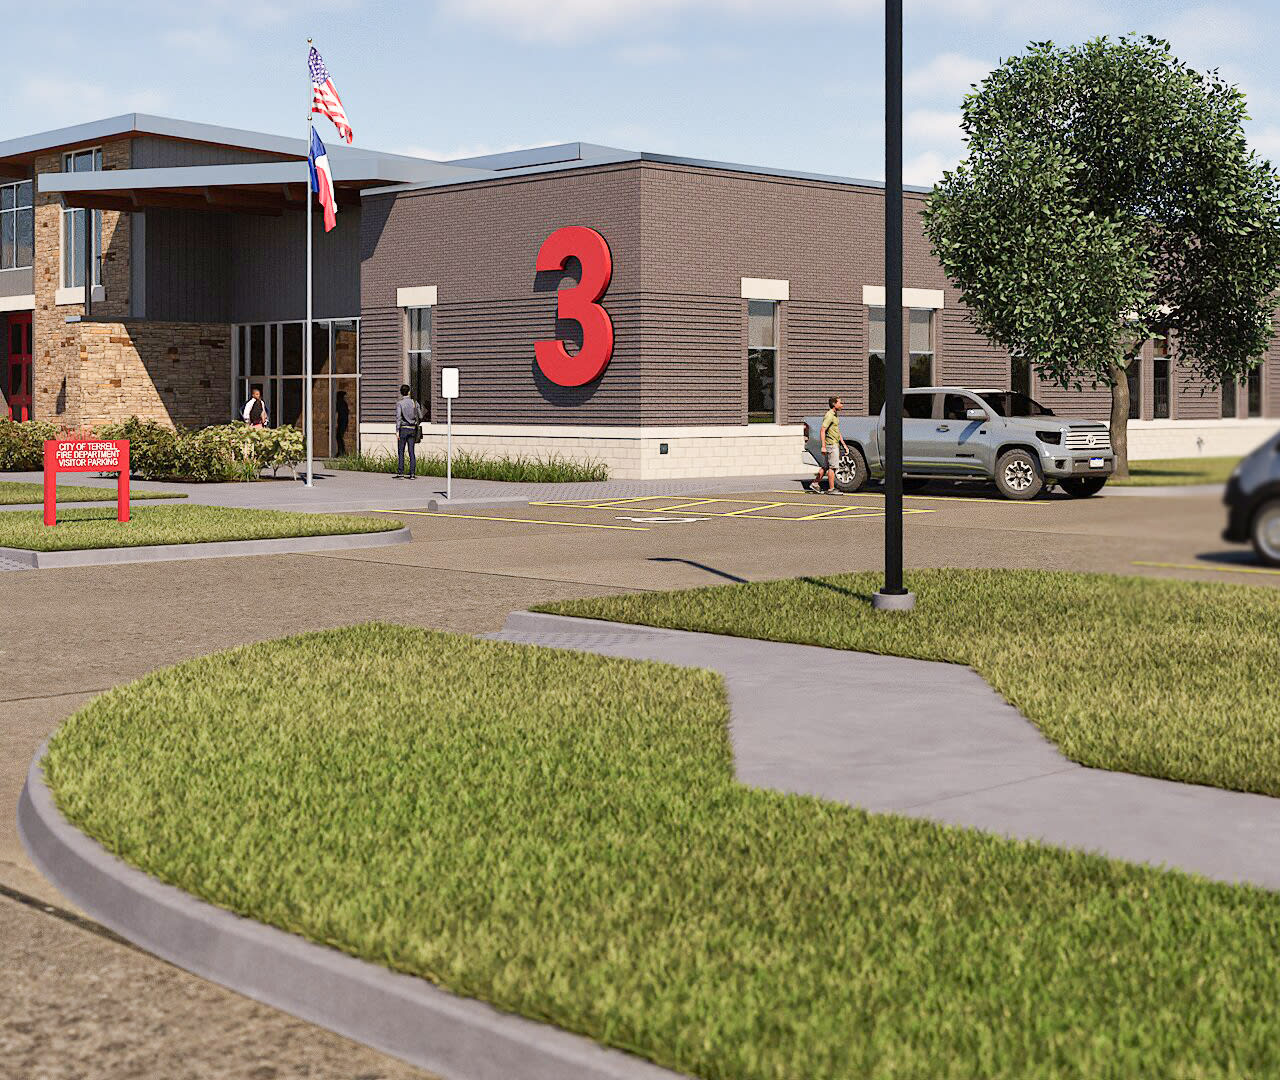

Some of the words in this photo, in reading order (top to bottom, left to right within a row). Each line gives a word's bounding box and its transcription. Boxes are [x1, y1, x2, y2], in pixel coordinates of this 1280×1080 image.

[534, 225, 613, 387] 3
[59, 443, 75, 451] CITY
[87, 442, 118, 450] TERRELL
[56, 451, 72, 459] FIRE
[74, 450, 120, 458] DEPARTMENT
[59, 459, 86, 467] VISITOR
[87, 458, 118, 466] PARKING
